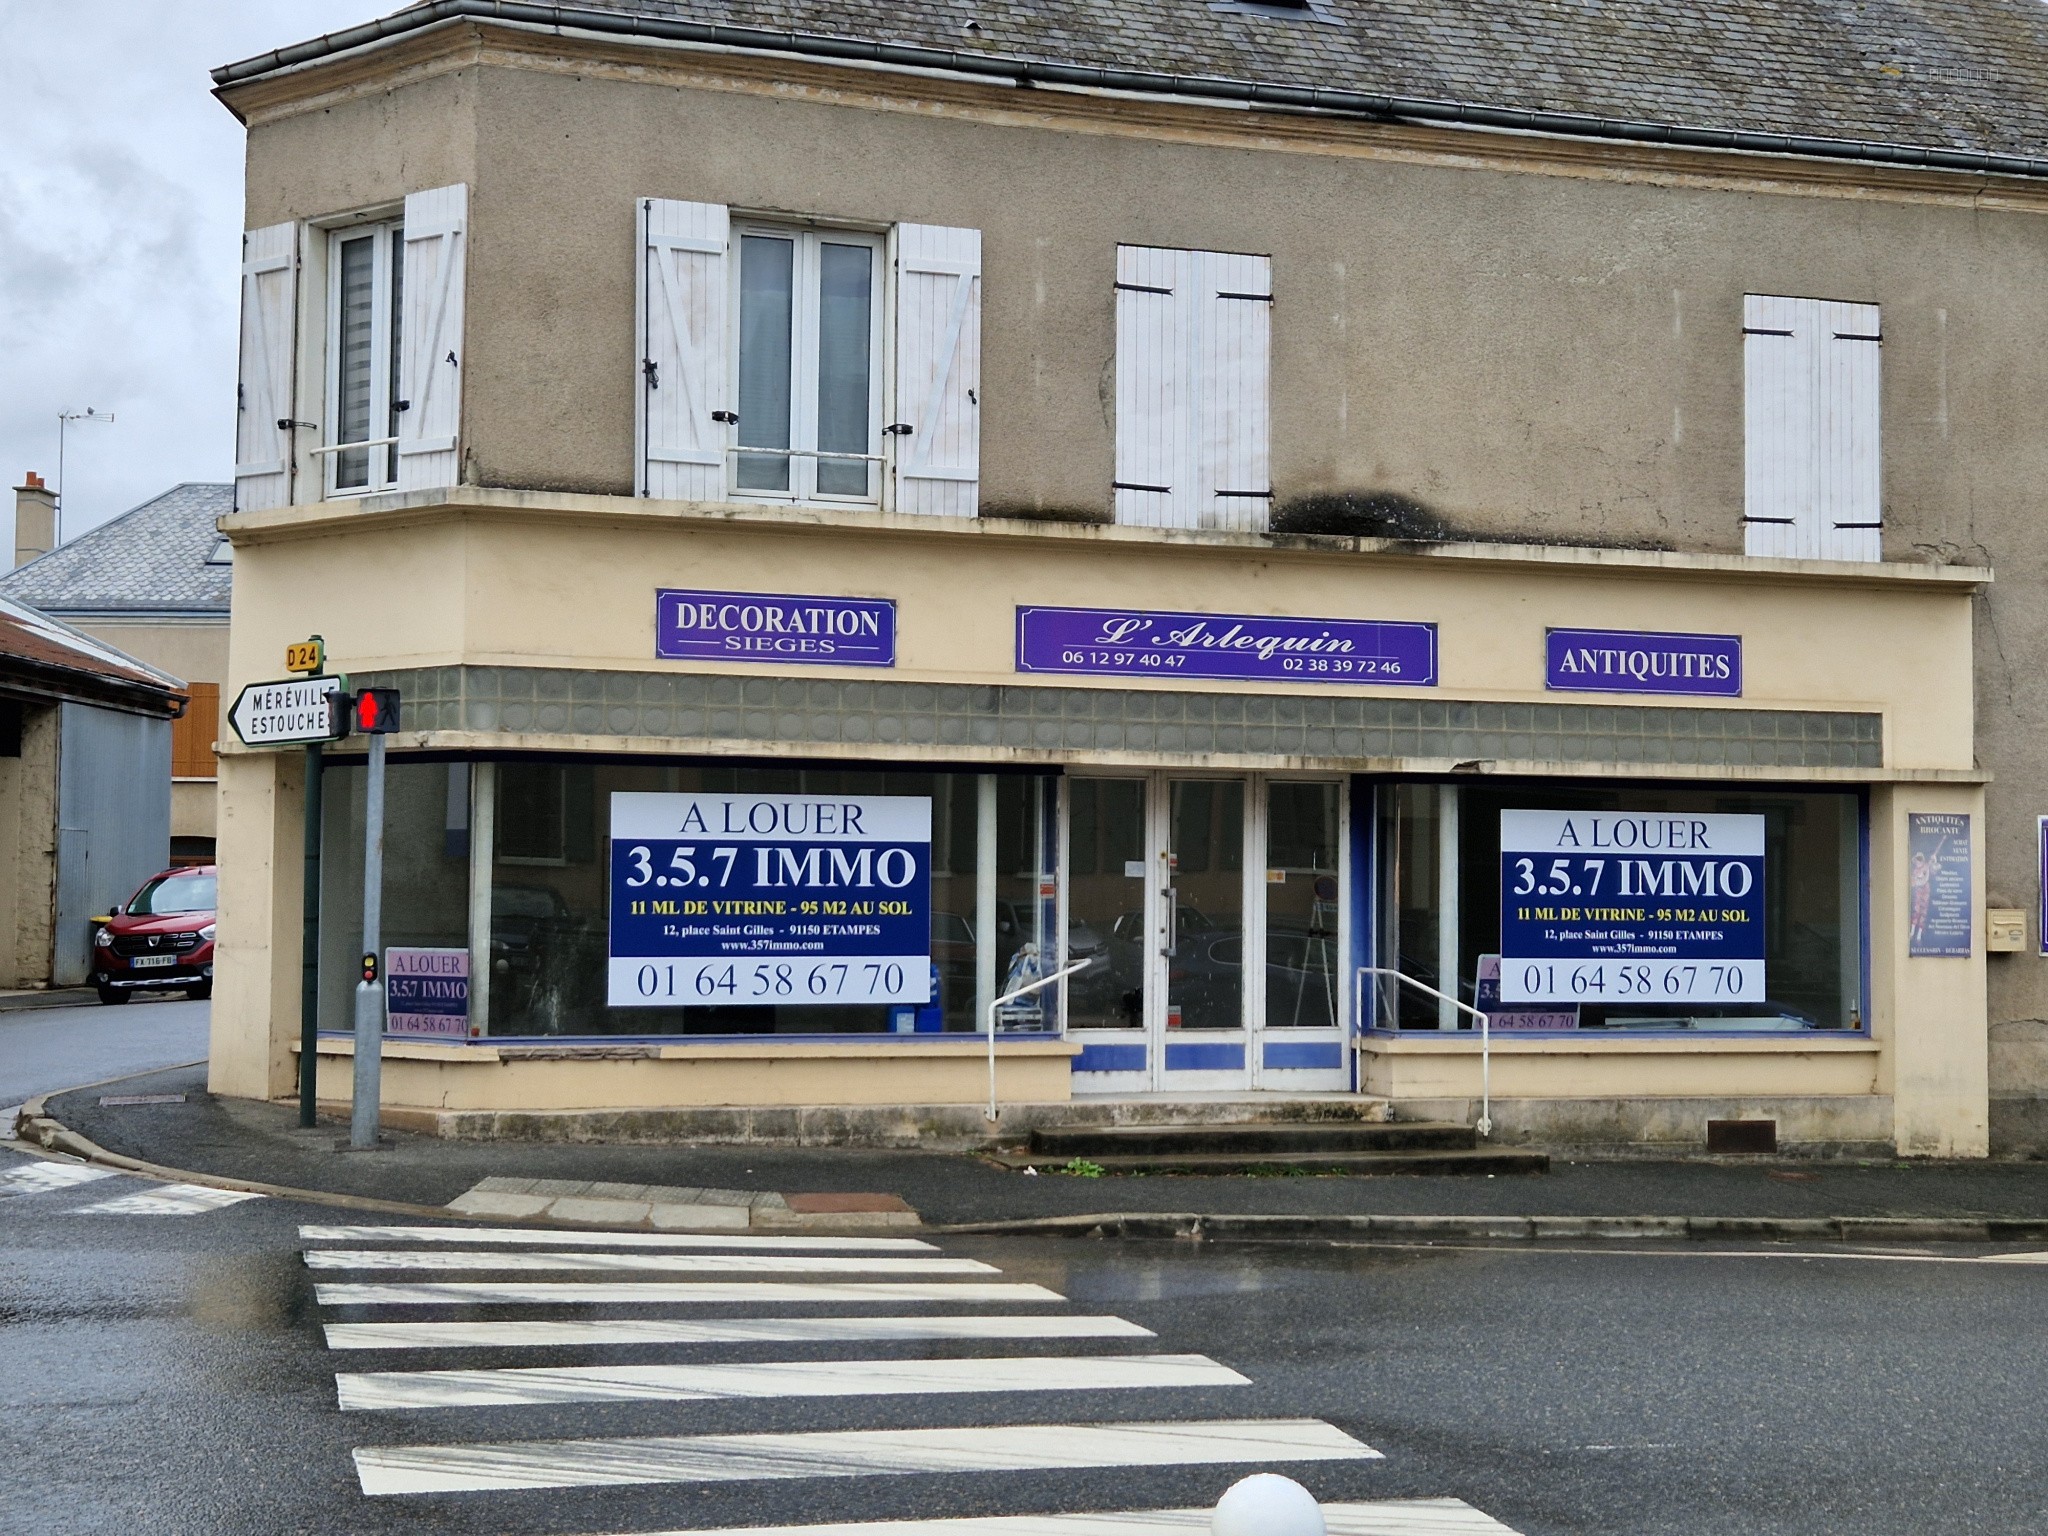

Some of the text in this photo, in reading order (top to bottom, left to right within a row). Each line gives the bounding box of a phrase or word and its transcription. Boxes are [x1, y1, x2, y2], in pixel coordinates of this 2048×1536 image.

[676, 602, 880, 637] DECORATION
[725, 636, 836, 654] SIEGES
[287, 646, 316, 666] D 24
[1062, 651, 1186, 667] 06 12 97 40 47
[1559, 648, 1731, 682] ANTIQUITES
[1283, 658, 1401, 674] 02 38 39 72 46
[253, 686, 335, 711] MÉRÉVILL
[251, 711, 330, 734] ESTOUCHE
[679, 801, 868, 835] A LOUER
[1556, 818, 1713, 849] A LOUER
[626, 845, 917, 888] 3.5.7 IMMO
[1513, 858, 1753, 897] 3.5.7 IMMO
[631, 900, 646, 915] 11
[652, 900, 680, 915] ML
[684, 900, 708, 915] DE
[713, 900, 787, 915] VITRINE
[801, 901, 819, 915] 95
[823, 901, 847, 915] M2
[850, 901, 875, 915] AU
[878, 900, 913, 915] SOL
[1517, 907, 1531, 920] 11
[1535, 907, 1558, 920] ML
[1561, 907, 1581, 920] DE
[1584, 907, 1646, 921] VITRINE
[1657, 908, 1672, 921] 95
[1675, 909, 1696, 921] M2
[1698, 909, 1719, 922] AU
[1721, 909, 1750, 922] SOL
[663, 924, 679, 938] 12,
[682, 924, 710, 938] place
[712, 924, 741, 936] Saint
[743, 924, 774, 936] Gilles
[789, 925, 820, 936] 91150
[823, 924, 881, 936] ETAMPES
[1544, 929, 1558, 941] 12,
[1559, 929, 1583, 942] place
[1585, 929, 1608, 940] Saint
[1610, 929, 1636, 940] Gilles
[1648, 930, 1674, 940] 91150
[1675, 930, 1724, 941] ETAMPES
[721, 939, 825, 951] www.357immo.com
[1592, 943, 1677, 954] www.357immo.com
[395, 955, 461, 974] A LOUER
[637, 964, 676, 997] 01
[695, 963, 738, 996] 64
[752, 963, 794, 996] 58
[808, 962, 849, 995] 67
[863, 962, 905, 995] 70
[1524, 965, 1744, 995] 01 64 58 67 70
[390, 980, 467, 999] 3.5.7 IMMO
[391, 1016, 403, 1031] 01
[407, 1016, 420, 1031] 64
[423, 1017, 436, 1032] 58
[439, 1018, 451, 1032] 67
[1499, 1015, 1514, 1028] 64
[1519, 1015, 1535, 1028] 58
[1538, 1014, 1554, 1028] 67
[1559, 1015, 1574, 1028] 70
